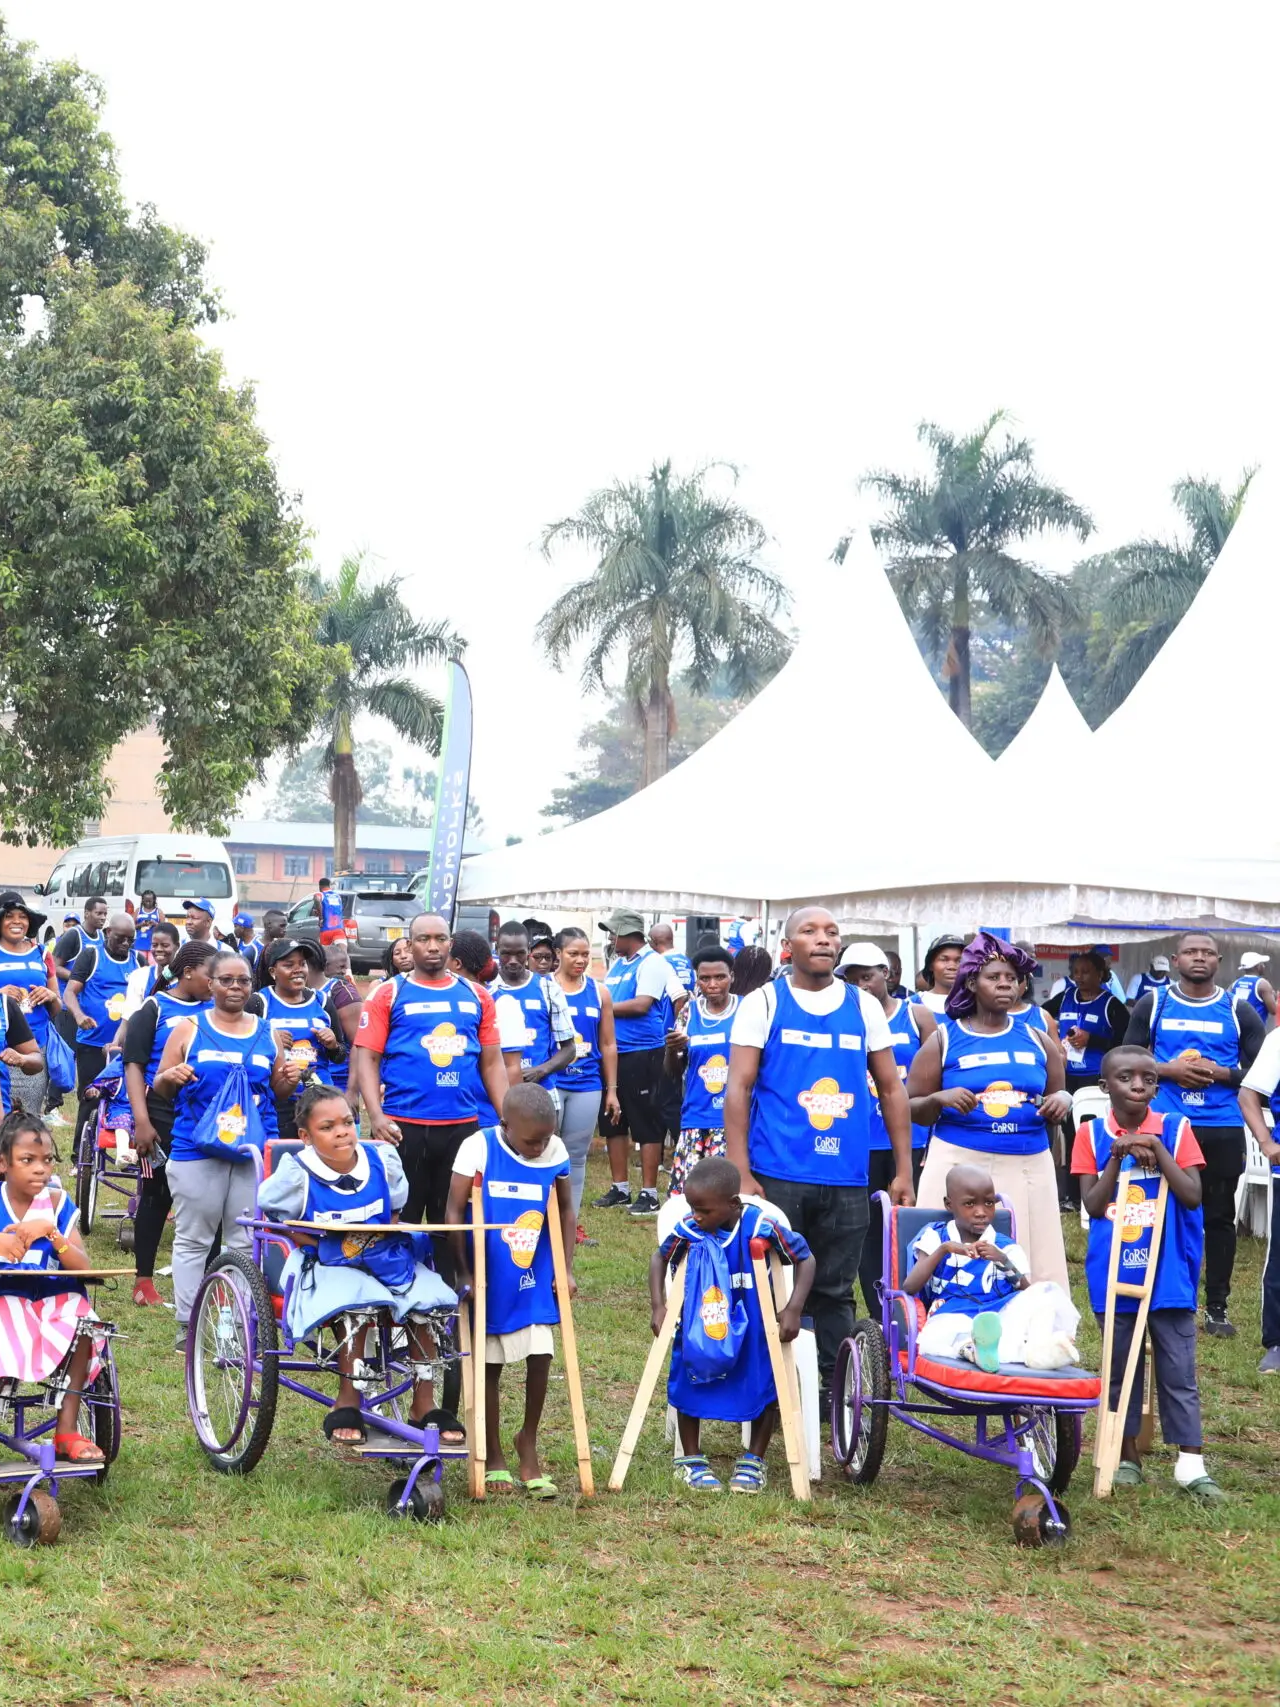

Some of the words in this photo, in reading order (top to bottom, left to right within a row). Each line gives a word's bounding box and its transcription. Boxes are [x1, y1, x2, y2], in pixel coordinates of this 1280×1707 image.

[436, 1072, 460, 1082] CoRSU
[798, 1092, 853, 1109] CoRSU
[1181, 1091, 1205, 1101] CoRSU
[814, 1136, 840, 1150] CoRSU
